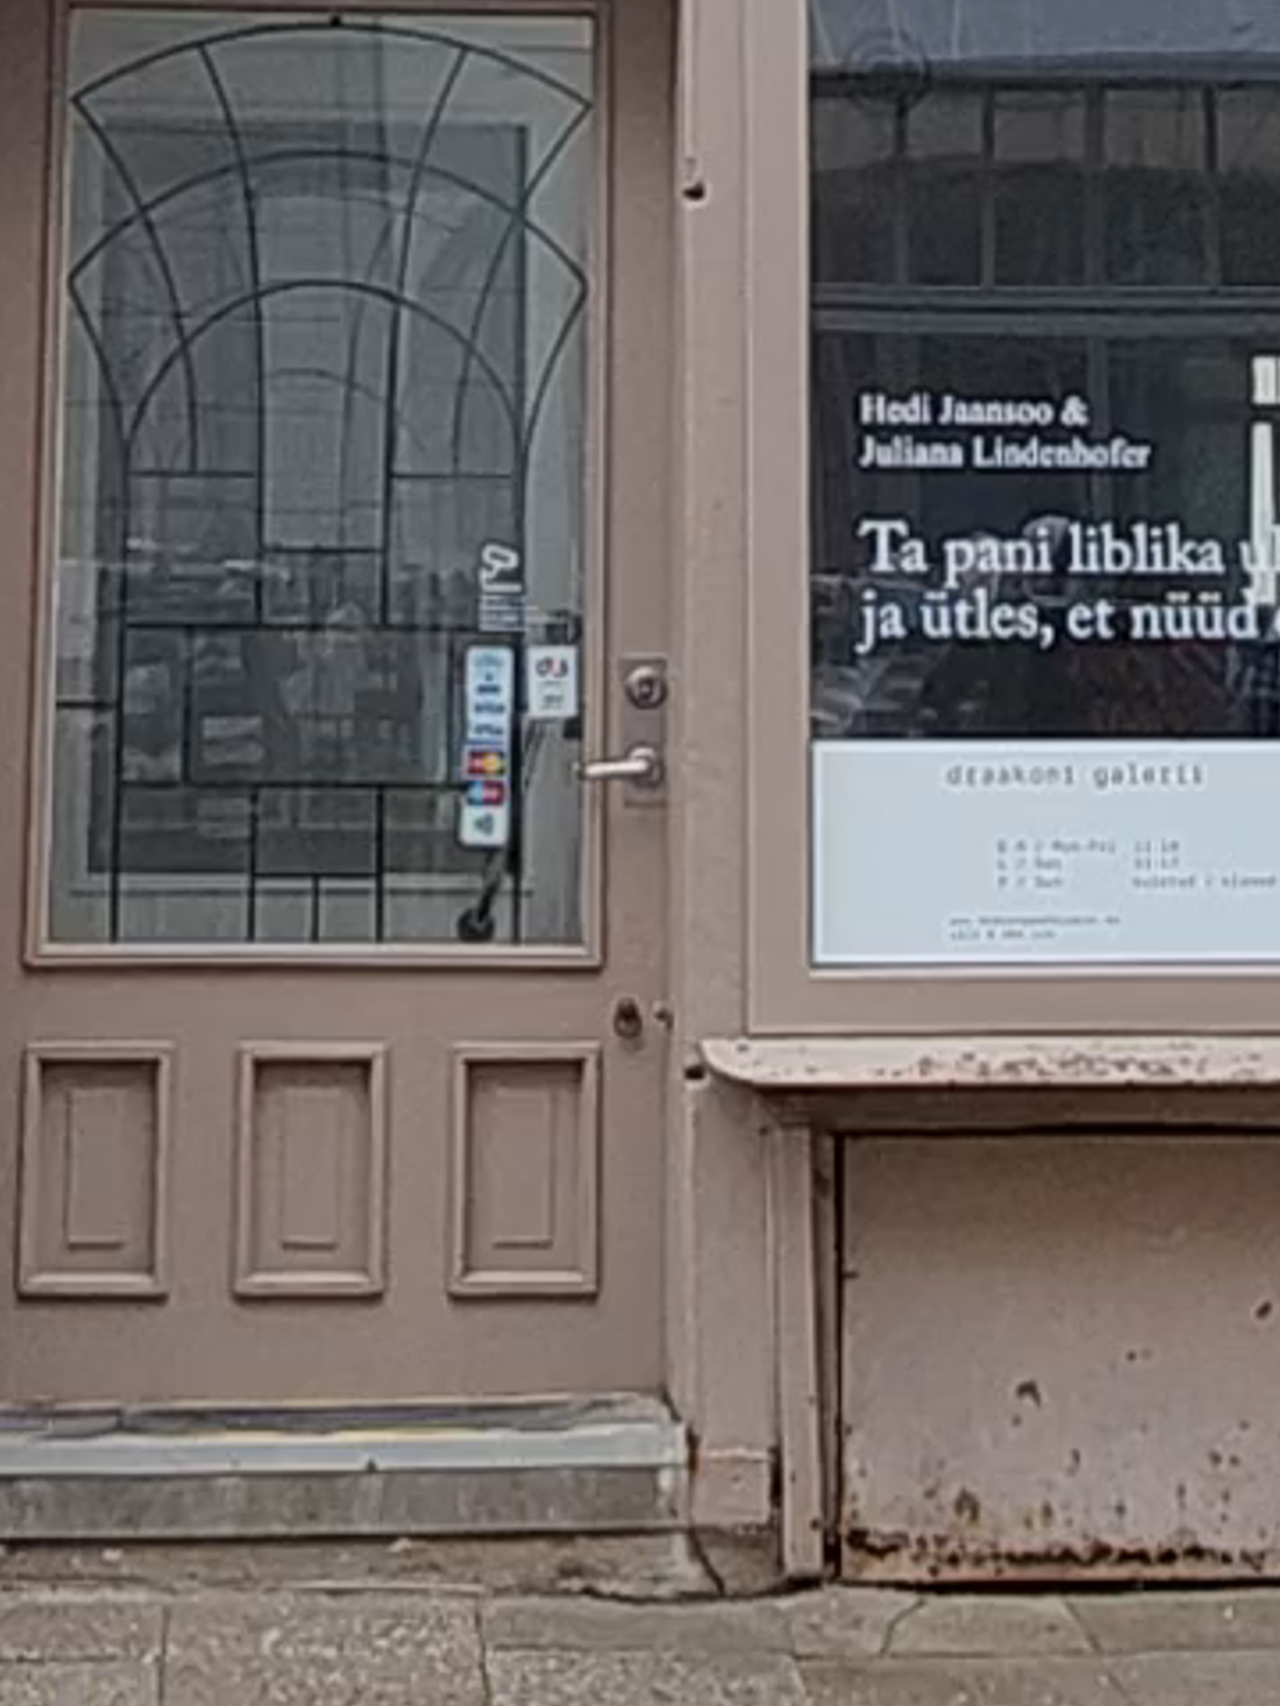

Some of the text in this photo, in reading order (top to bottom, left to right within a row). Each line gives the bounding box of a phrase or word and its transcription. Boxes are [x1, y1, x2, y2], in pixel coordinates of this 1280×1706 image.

[860, 394, 1089, 426] Hedi Jaansoo &
[857, 436, 1151, 470] Juliana Lindenhofer
[856, 519, 926, 576] Ta
[943, 526, 1053, 587] pani
[1068, 524, 1224, 577] liblika
[853, 597, 905, 654] ja
[920, 591, 1055, 647] ütles,
[1068, 602, 1116, 642] et
[1130, 590, 1258, 642] nüüd
[945, 764, 1204, 790] draakoni galerii
